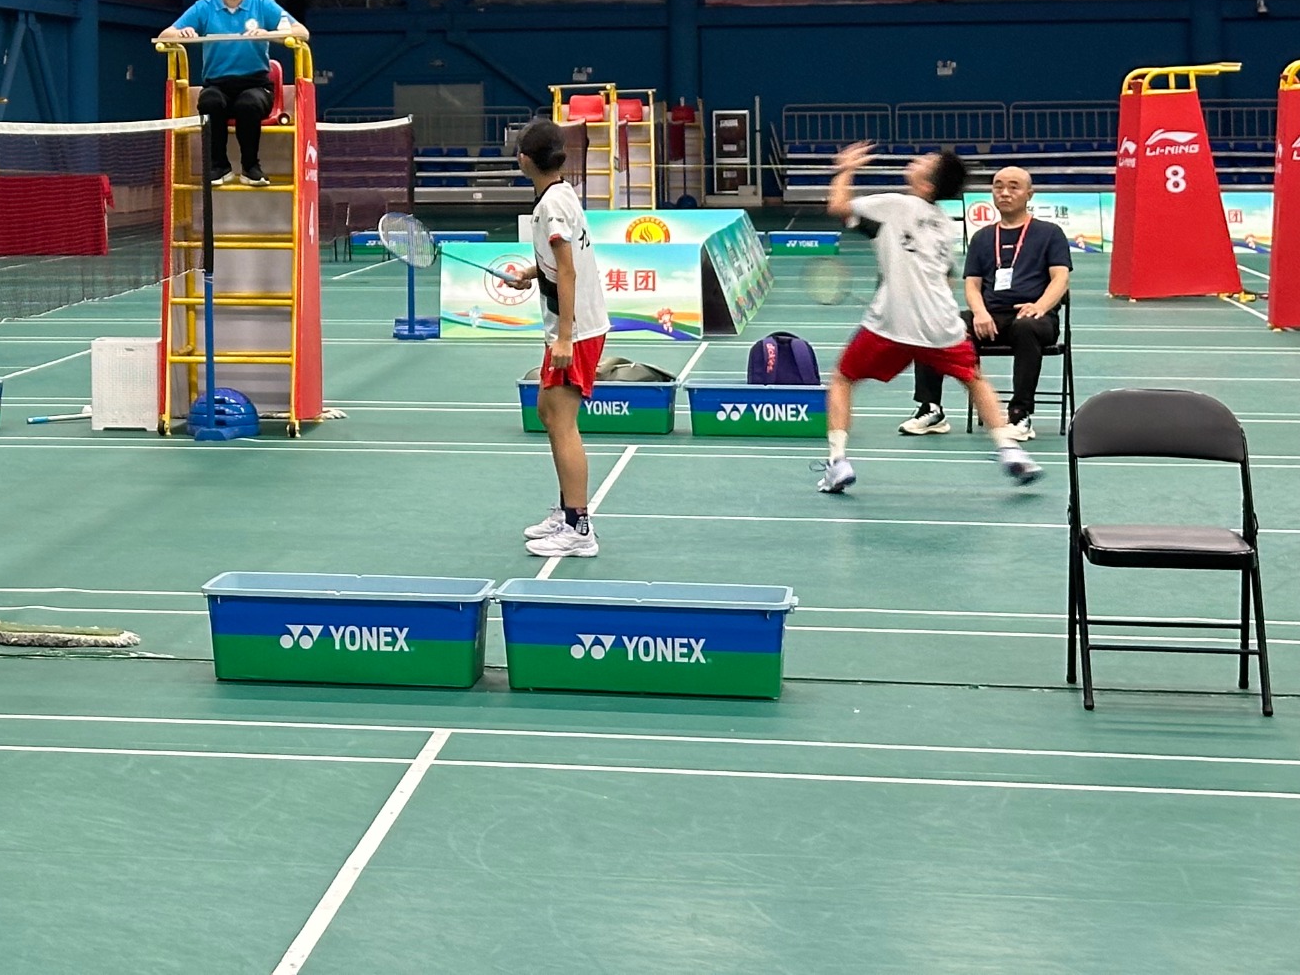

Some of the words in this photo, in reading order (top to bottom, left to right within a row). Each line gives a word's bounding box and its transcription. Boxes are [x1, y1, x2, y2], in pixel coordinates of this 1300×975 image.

[1146, 144, 1199, 156] LI-NING
[1165, 165, 1187, 193] 8
[598, 268, 657, 292] 集团
[584, 401, 630, 416] YONEX
[751, 404, 809, 422] YONEX
[329, 625, 410, 652] YONEX
[621, 636, 706, 664] YONEX
